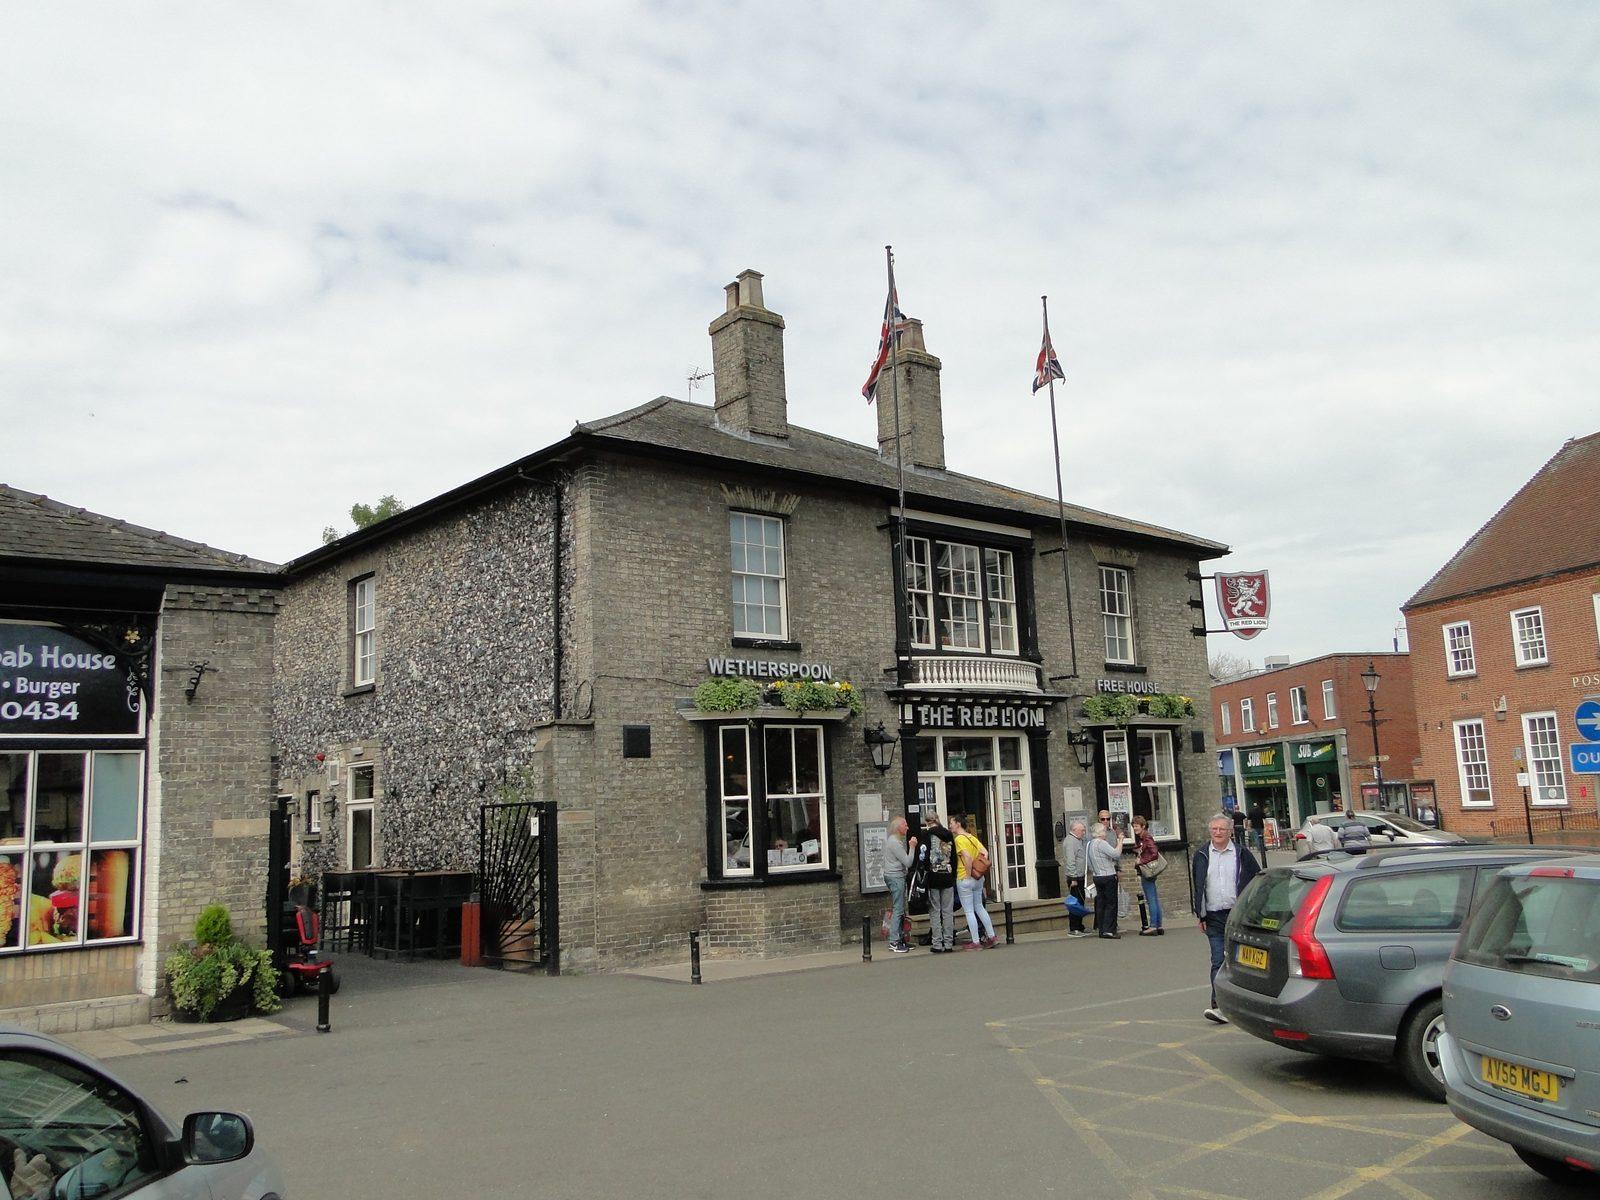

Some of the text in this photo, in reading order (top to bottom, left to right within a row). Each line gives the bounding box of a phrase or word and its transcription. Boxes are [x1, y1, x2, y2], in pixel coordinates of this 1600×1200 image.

[0, 644, 116, 670] ab House
[708, 658, 832, 679] WETHERSPOON
[16, 677, 80, 699] Burger
[1097, 679, 1160, 694] FREE HOUSE
[917, 705, 1040, 727] THE RED LION
[1247, 748, 1276, 768] SUBWAY
[1297, 743, 1311, 759] SUB
[1487, 1057, 1517, 1086] AV56
[1521, 1068, 1551, 1095] MGJ
